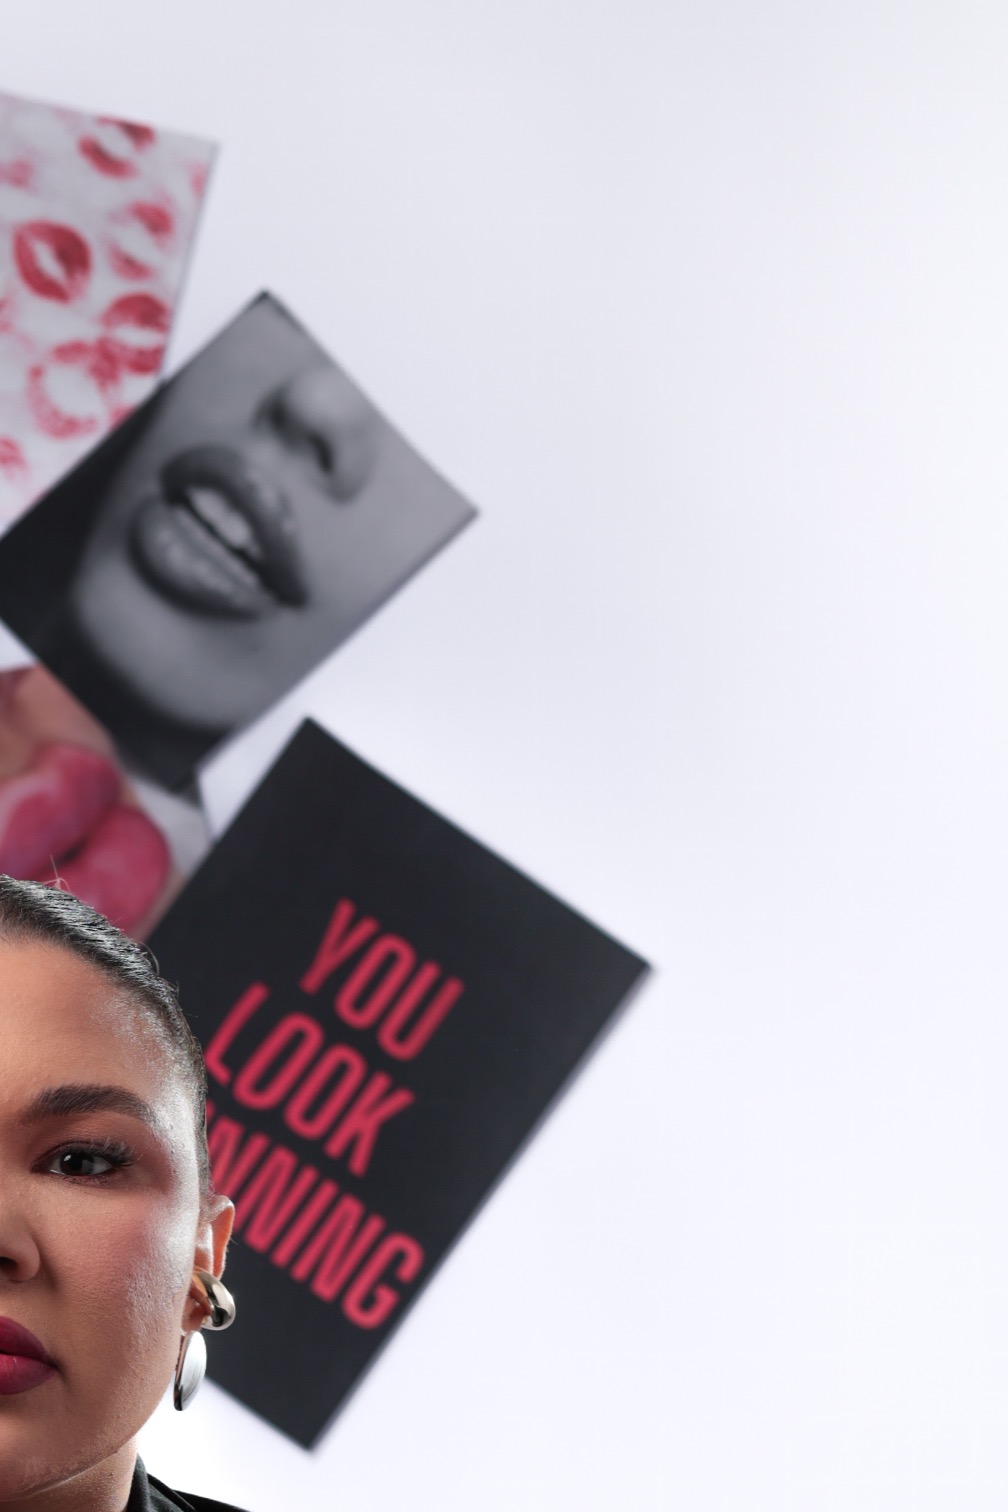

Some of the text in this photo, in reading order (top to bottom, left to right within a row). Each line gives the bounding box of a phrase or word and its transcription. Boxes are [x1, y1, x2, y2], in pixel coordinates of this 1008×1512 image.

[300, 899, 463, 1060] YOU
[205, 982, 414, 1175] LOOK
[206, 1099, 424, 1328] NNING
